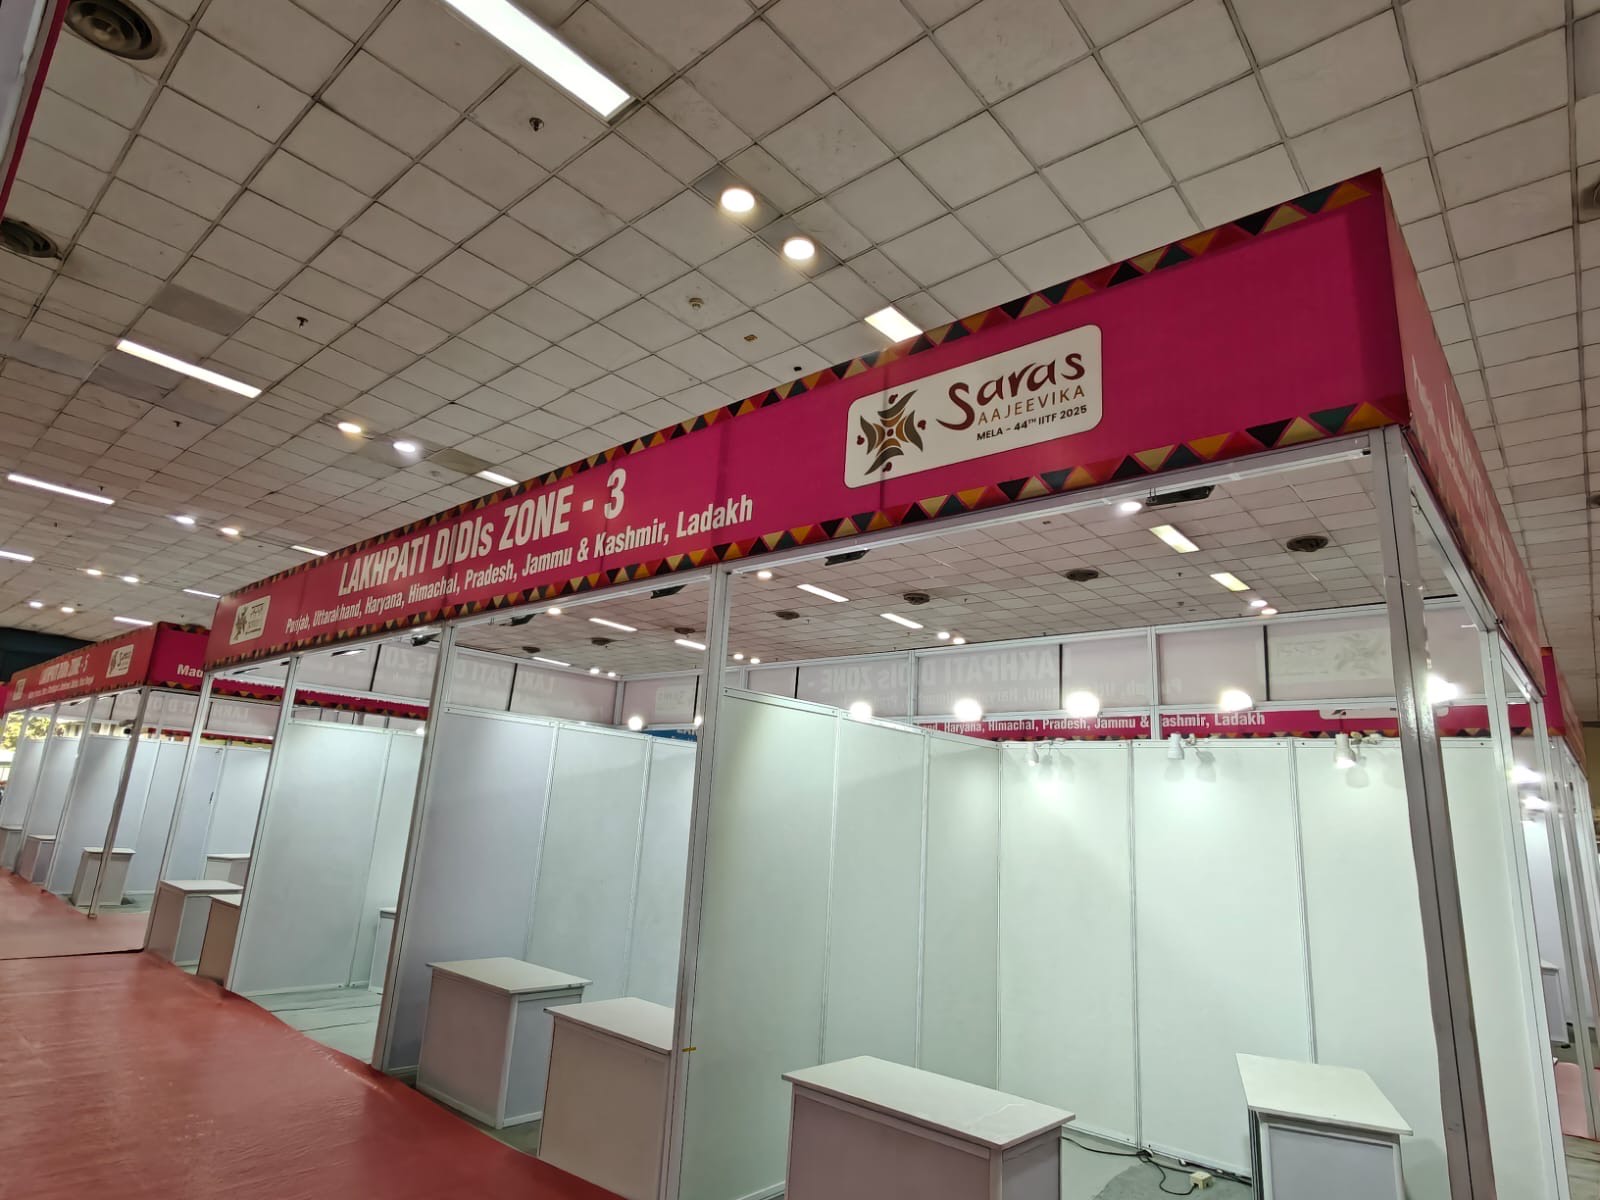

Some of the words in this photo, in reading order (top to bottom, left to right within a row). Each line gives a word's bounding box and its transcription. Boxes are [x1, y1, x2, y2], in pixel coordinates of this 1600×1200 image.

[935, 352, 1086, 431] Saras
[977, 384, 1086, 426] AAJEEVIKA
[976, 427, 1004, 441] MELA
[1038, 413, 1058, 426] IITF
[1059, 404, 1088, 420] 2025
[338, 534, 431, 597] LAKHPATI
[432, 516, 495, 570] DIDIs
[499, 485, 575, 551] ZONE
[581, 498, 594, 512] -
[603, 468, 627, 520] 3
[285, 615, 311, 635] Punjab,
[313, 599, 362, 628] Uttarakhand,
[364, 592, 405, 616] Haryana,
[408, 572, 461, 604] Himachal,
[464, 559, 518, 591] Pradesh,
[521, 543, 573, 577] Jammu
[576, 537, 590, 562] &
[593, 517, 670, 559] Kashmir,
[676, 494, 754, 539] Ladakh
[988, 718, 1039, 732] Himachal,
[1042, 716, 1091, 731] Pradesh,
[1094, 716, 1136, 729] Jammu
[1140, 715, 1149, 729] &
[1161, 712, 1210, 728] ashmir,
[1214, 711, 1266, 726] Ladakh
